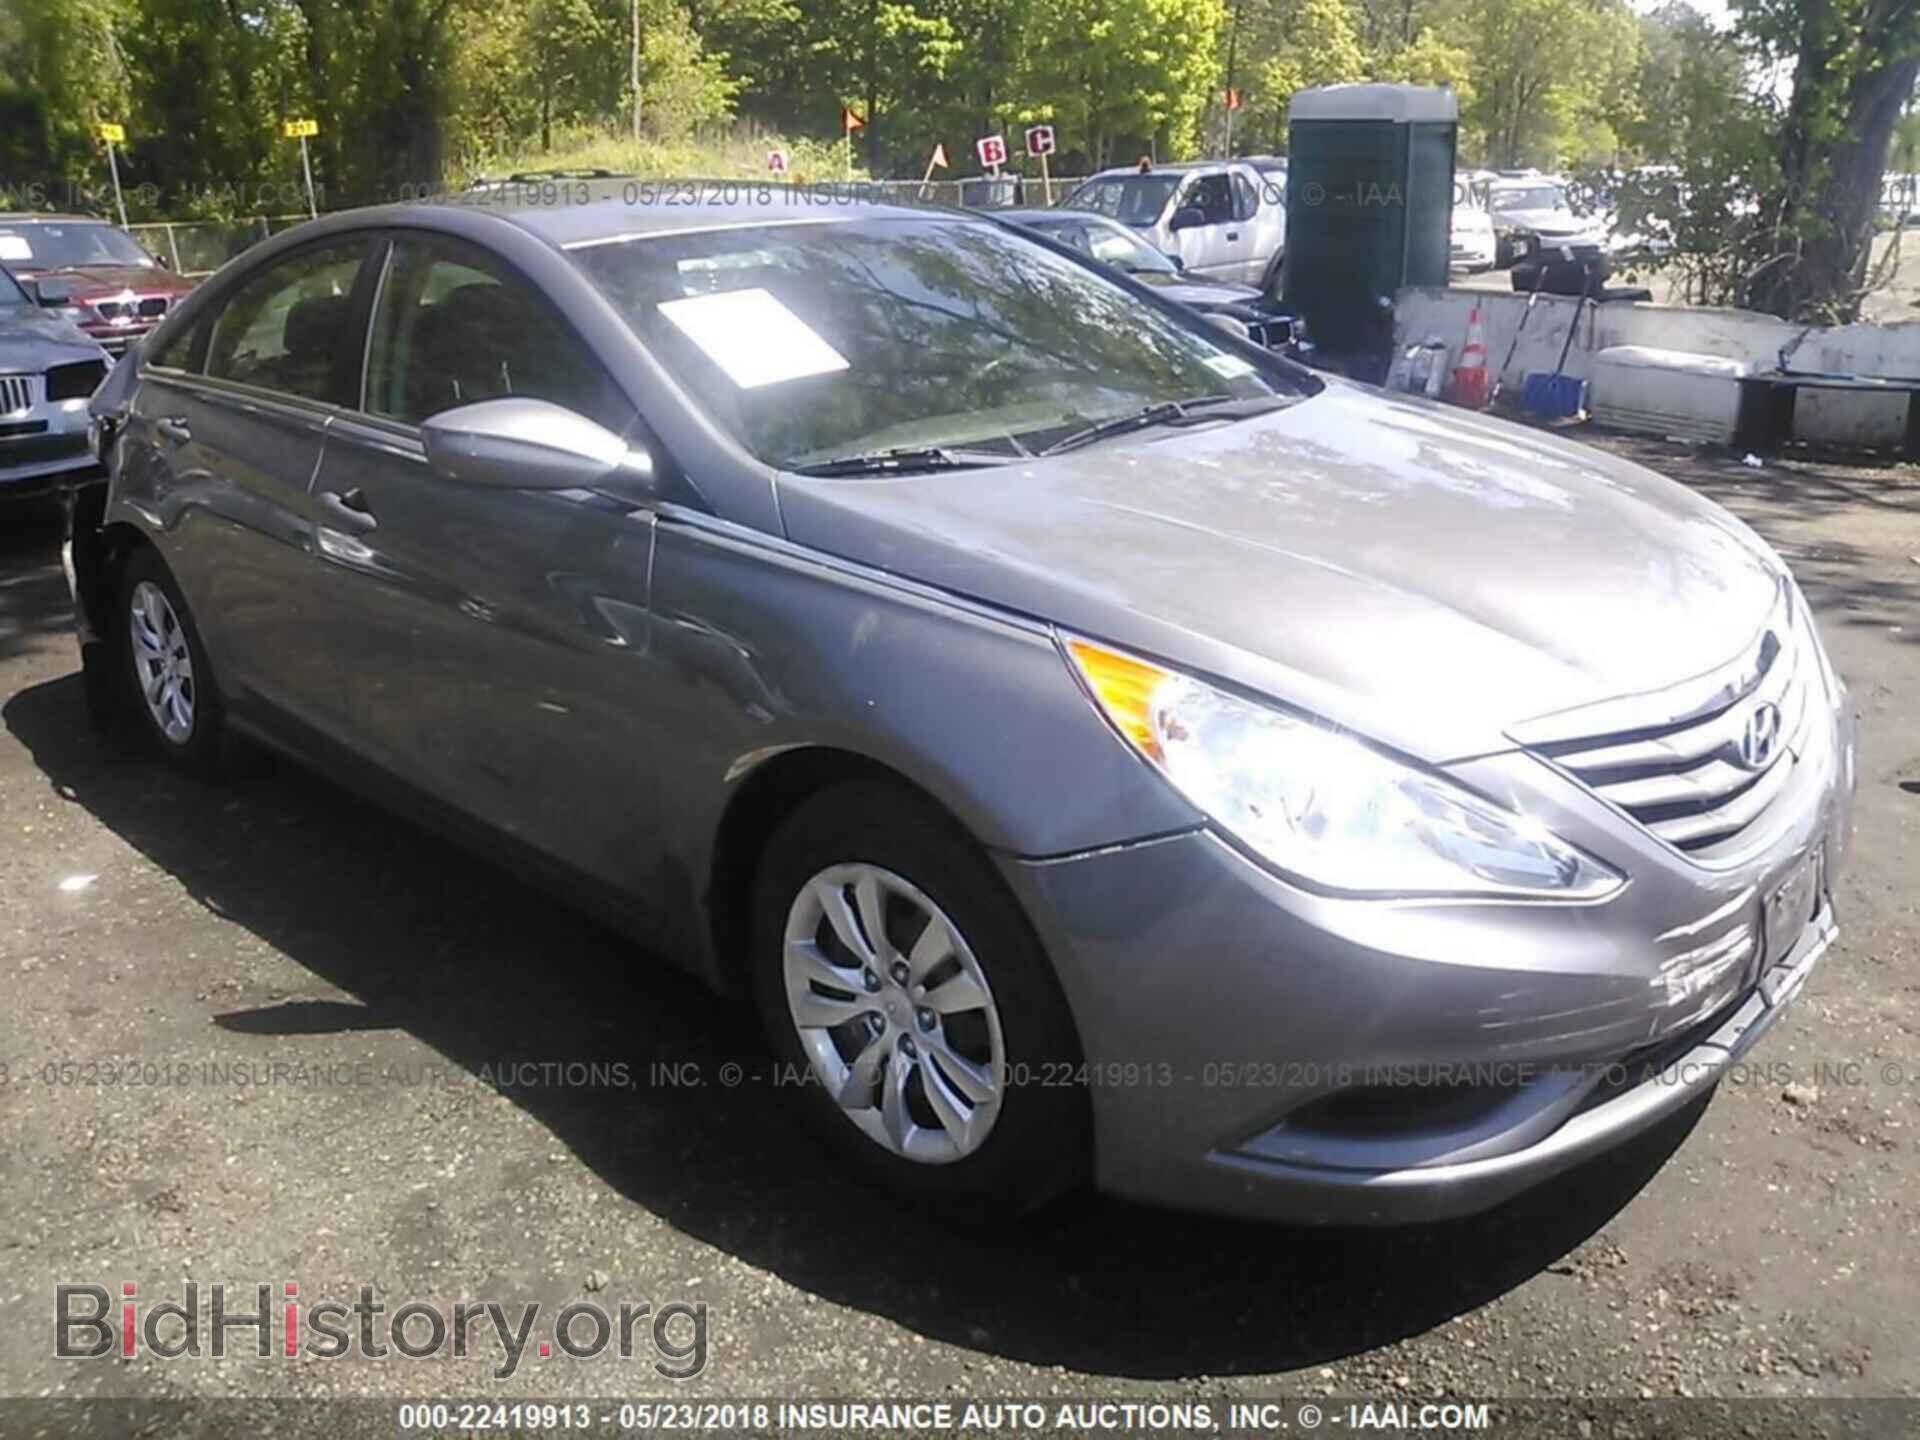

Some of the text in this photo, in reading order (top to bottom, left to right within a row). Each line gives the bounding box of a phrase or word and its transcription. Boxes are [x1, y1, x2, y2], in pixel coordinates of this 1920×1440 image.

[983, 140, 1003, 162] B
[1029, 127, 1053, 153] C
[767, 153, 785, 171] A
